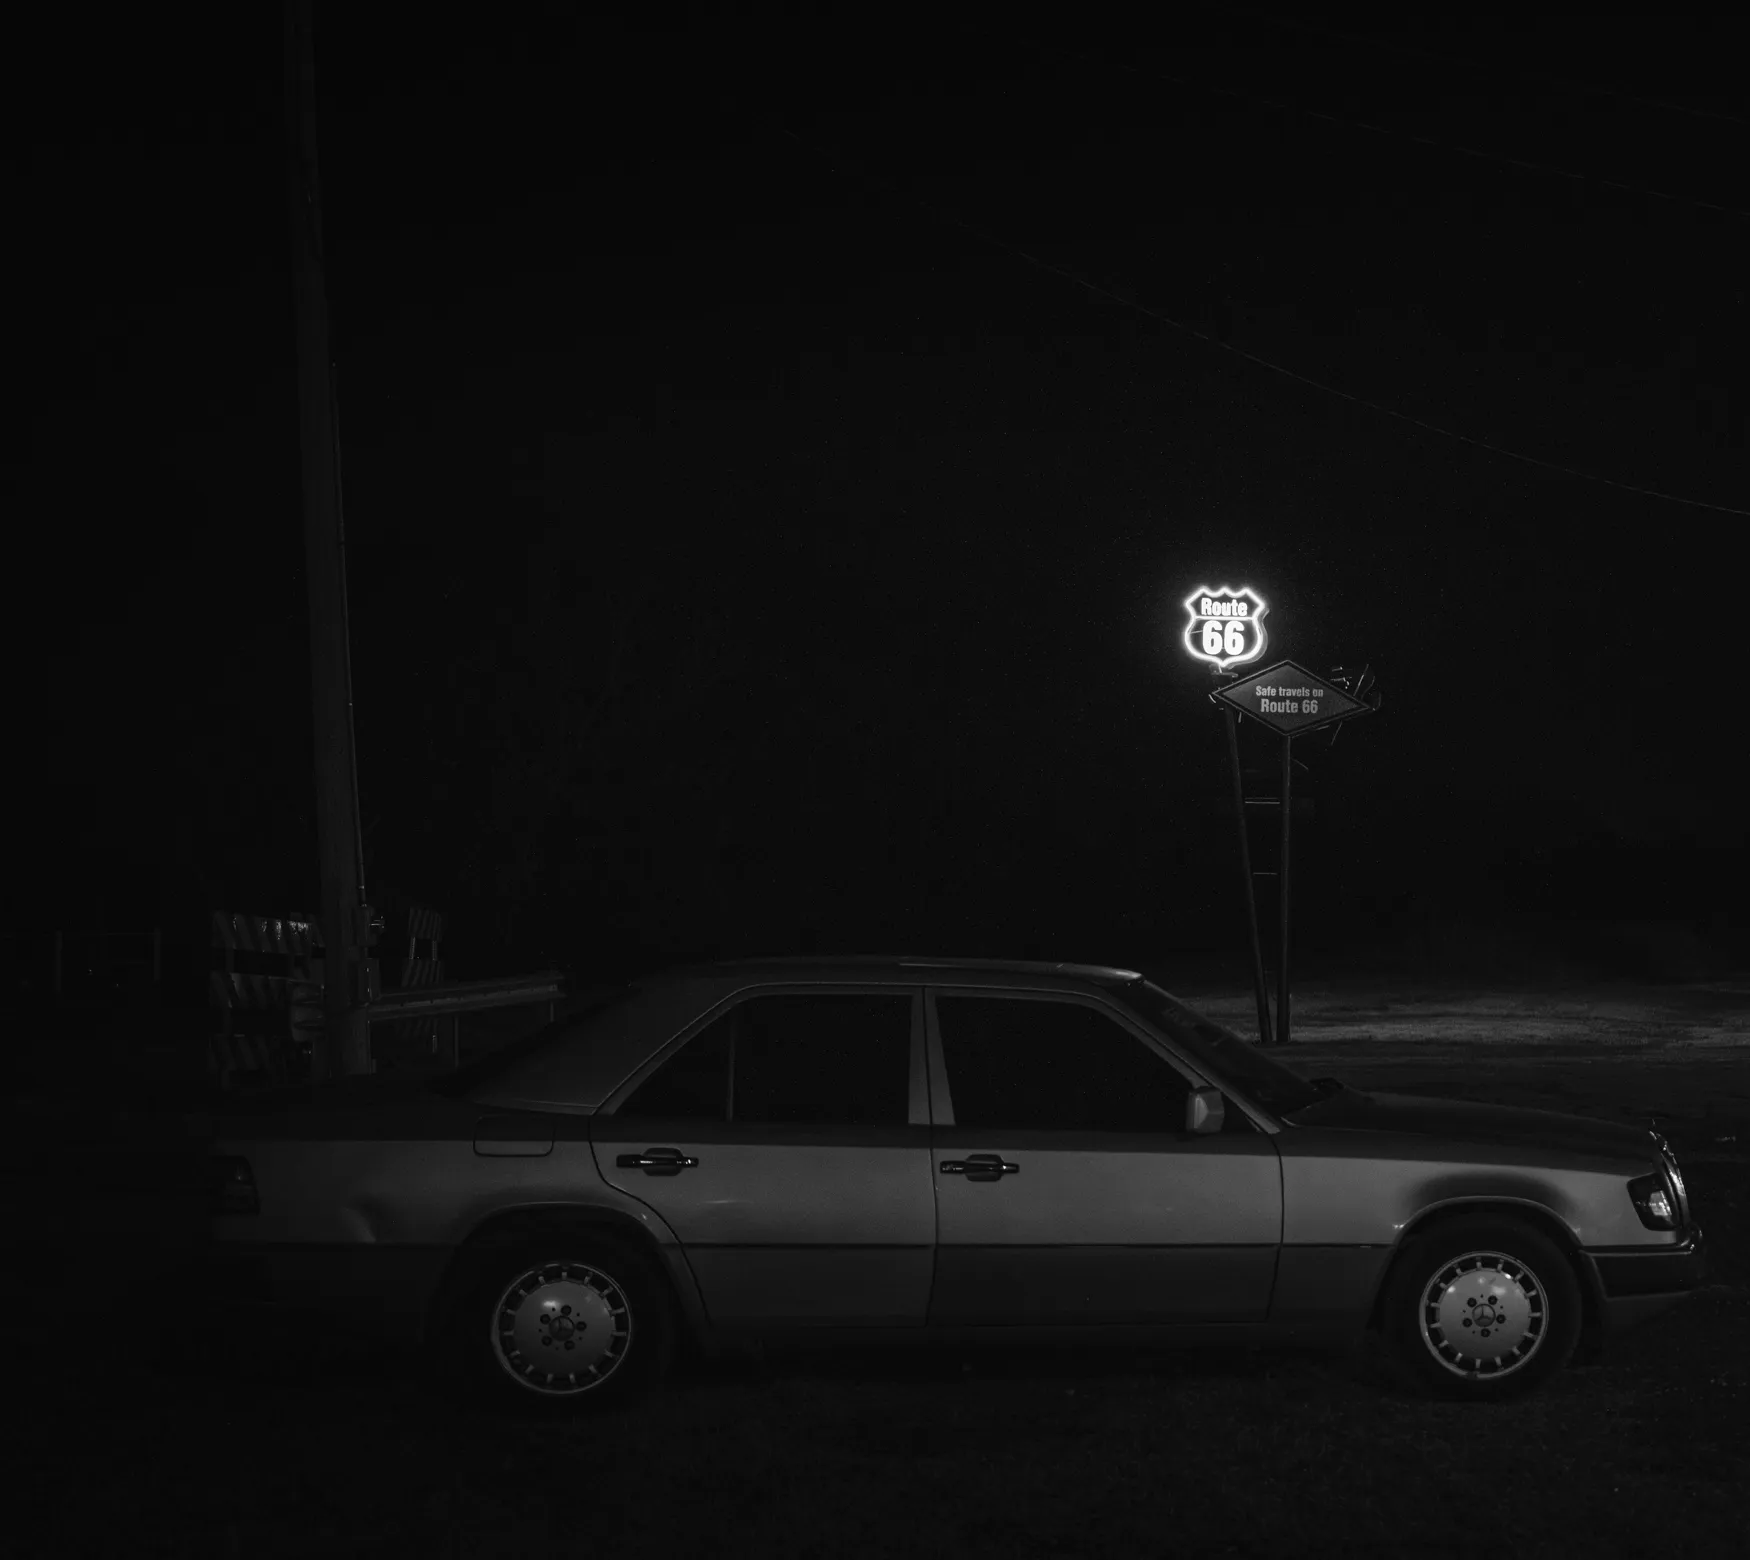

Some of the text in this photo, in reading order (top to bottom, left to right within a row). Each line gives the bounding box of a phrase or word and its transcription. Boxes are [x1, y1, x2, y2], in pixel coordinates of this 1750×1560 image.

[1201, 597, 1248, 616] Route
[1202, 620, 1245, 656] 66
[1255, 685, 1324, 698] Safe travels on
[1260, 698, 1319, 714] Route 66
